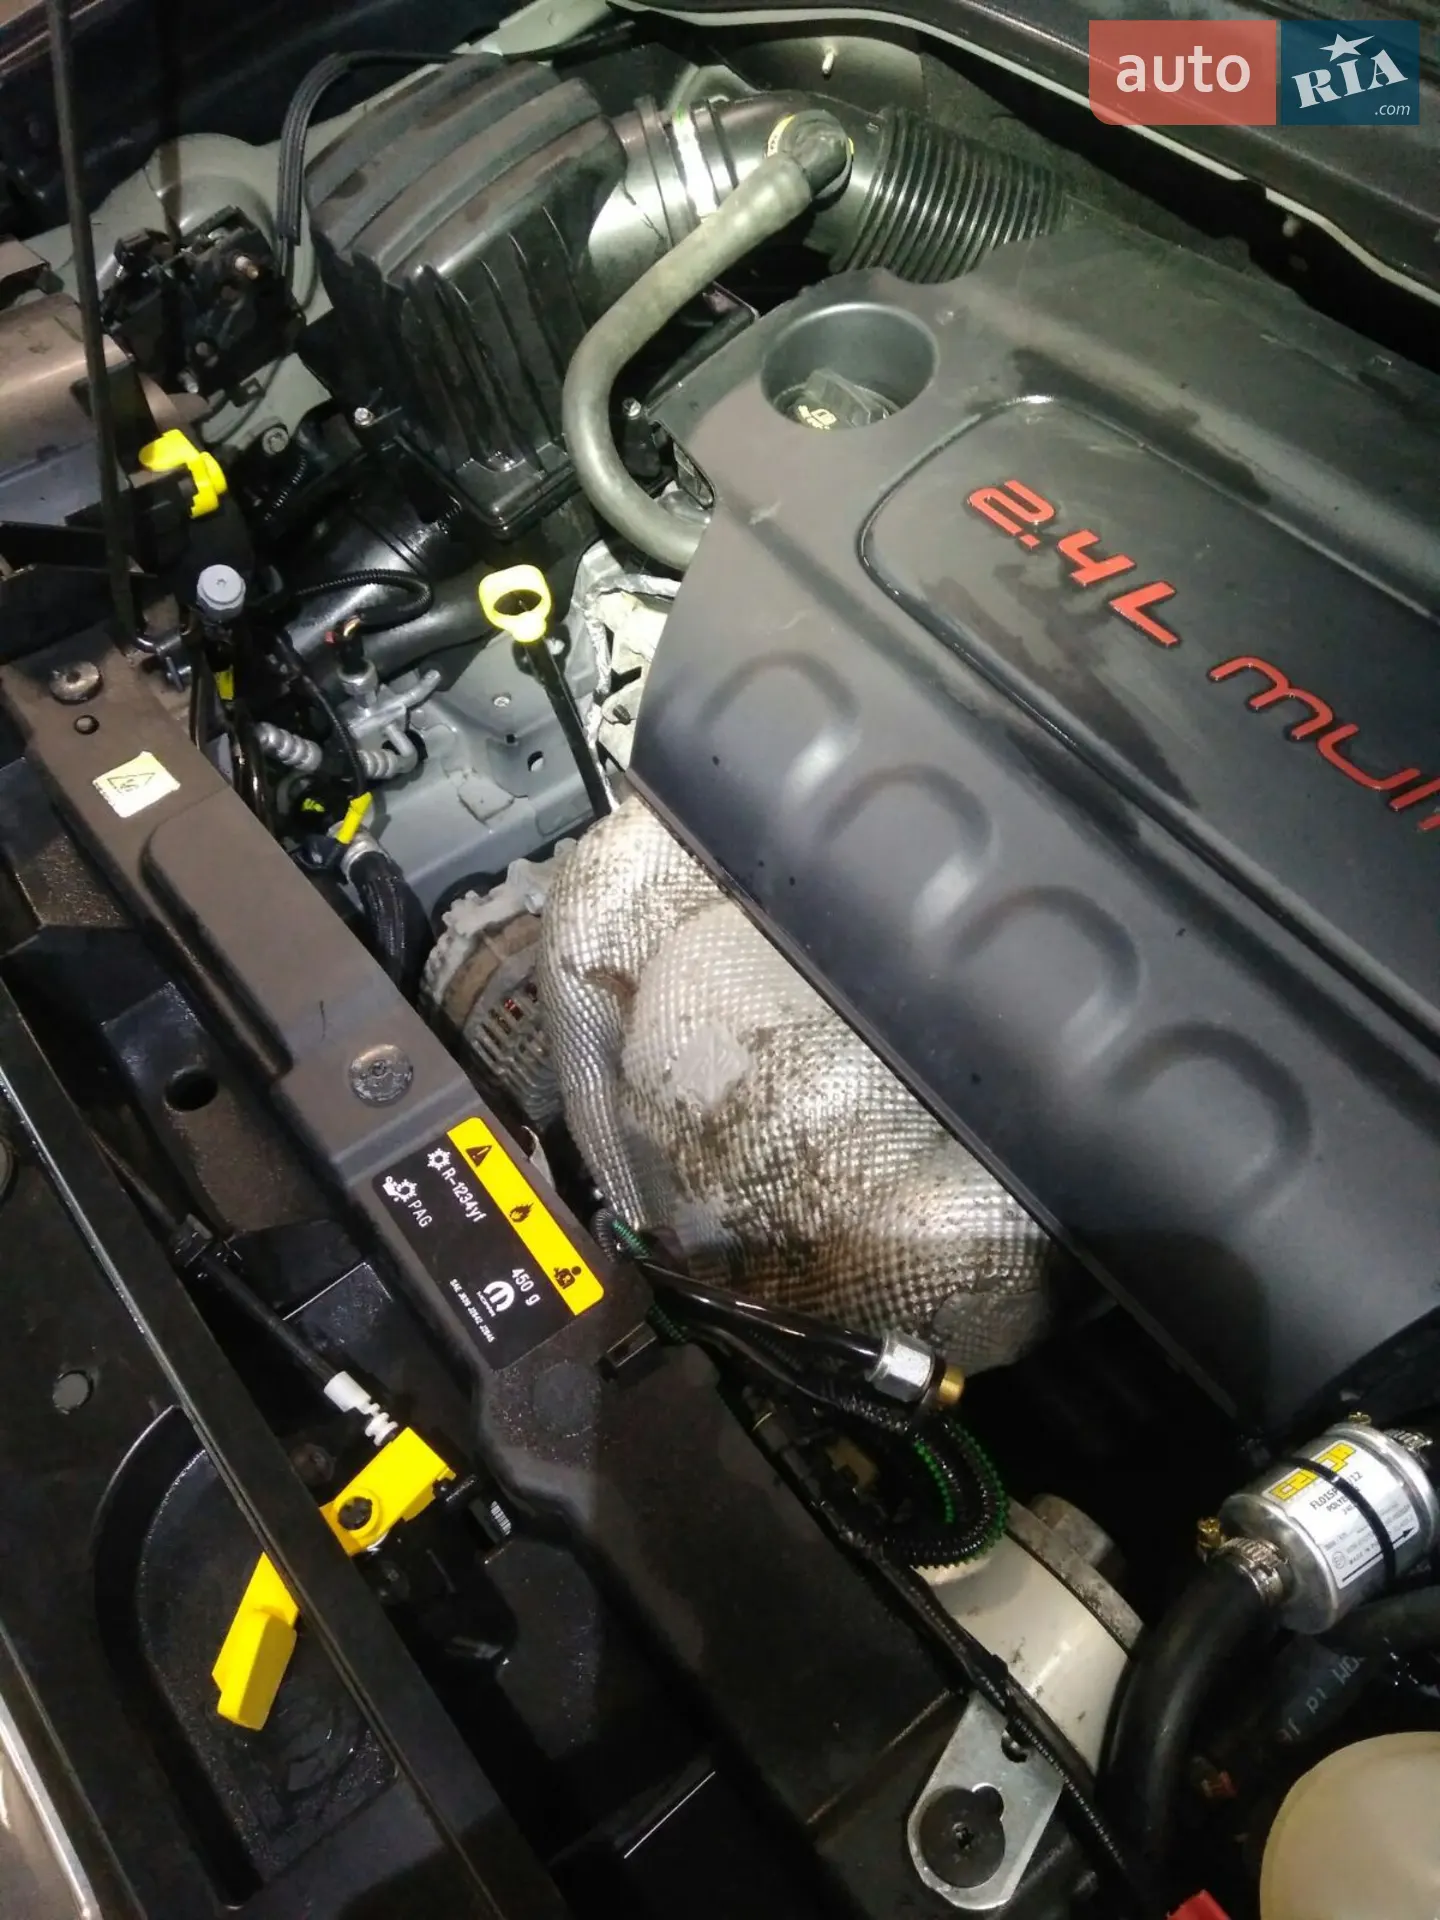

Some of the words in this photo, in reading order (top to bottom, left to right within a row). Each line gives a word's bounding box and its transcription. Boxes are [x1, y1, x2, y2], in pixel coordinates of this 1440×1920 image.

[967, 479, 1180, 647] 2.4L
[408, 1199, 433, 1228] PAG
[442, 1167, 487, 1223] R-1234yf
[511, 1268, 535, 1292] 450
[525, 1294, 541, 1306] g
